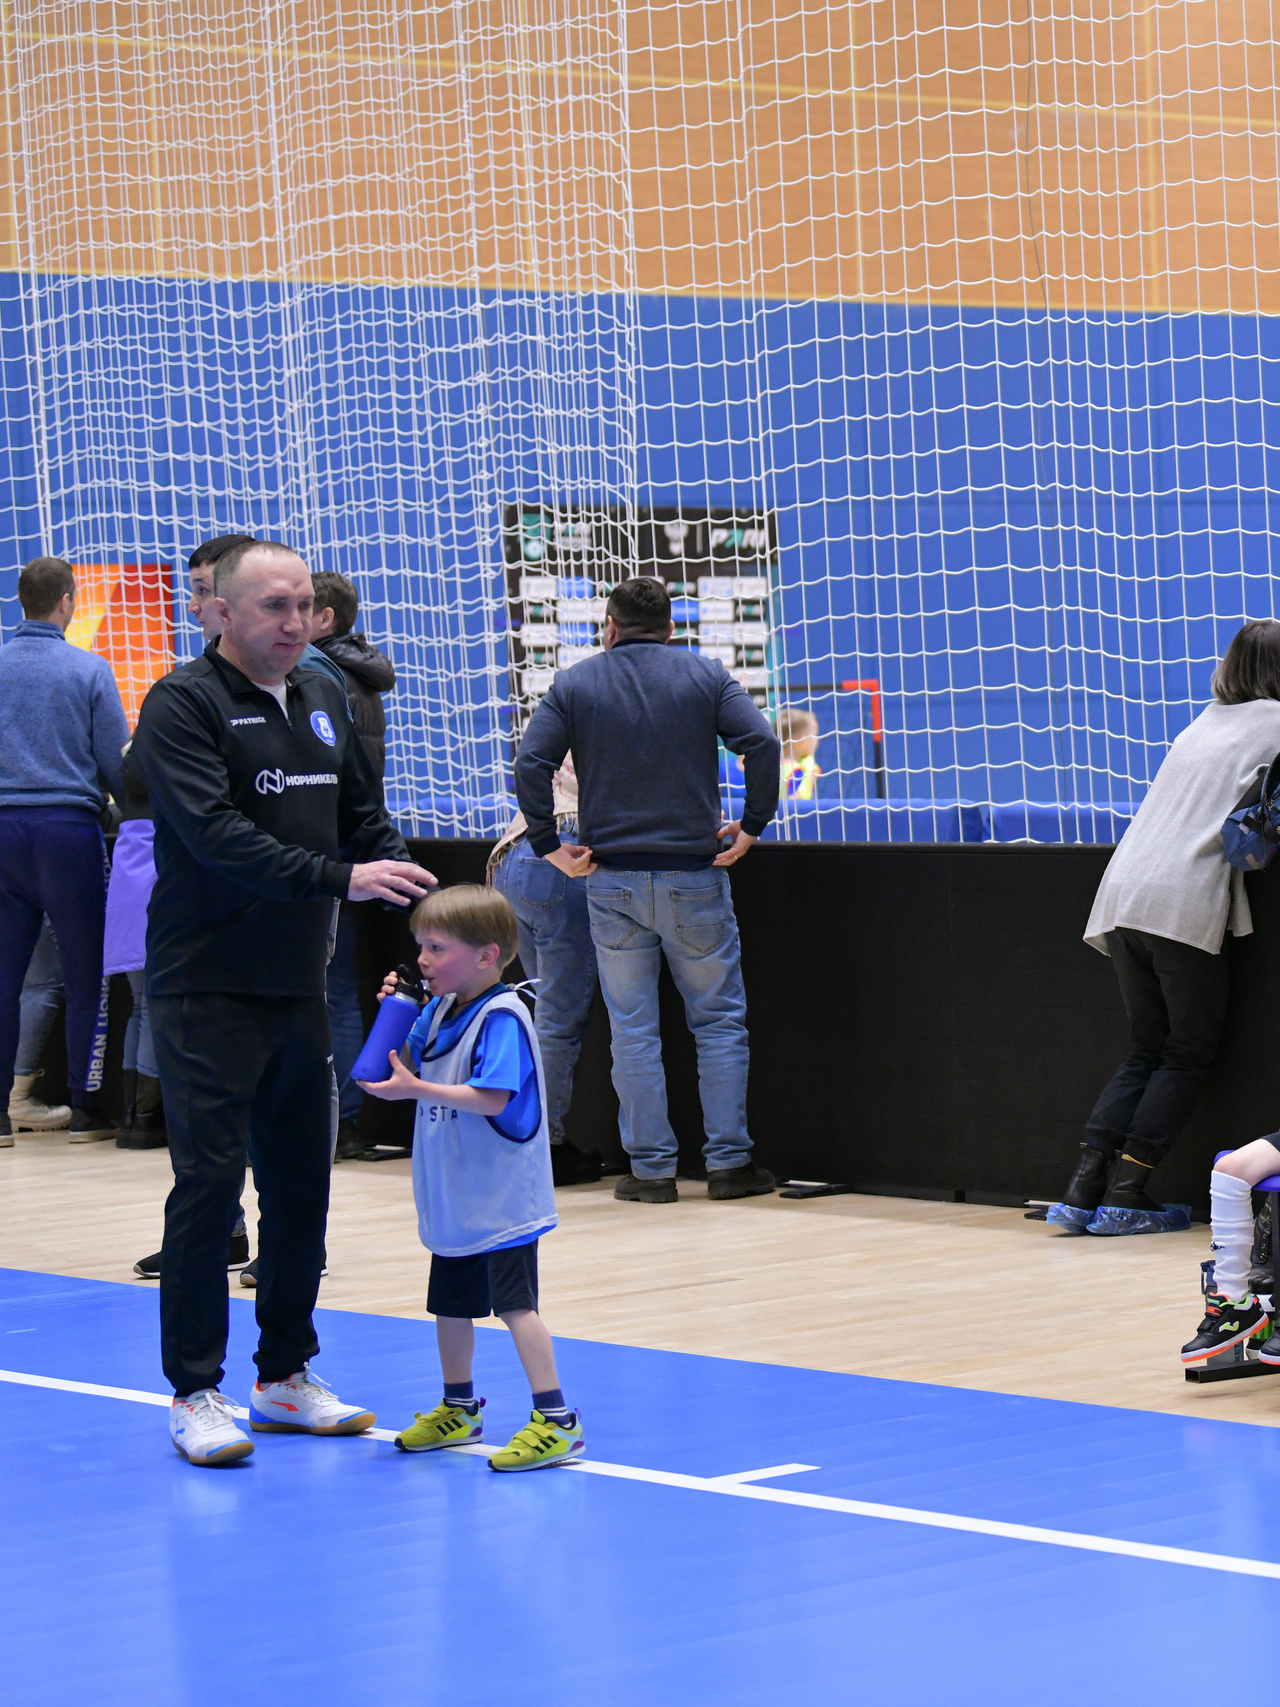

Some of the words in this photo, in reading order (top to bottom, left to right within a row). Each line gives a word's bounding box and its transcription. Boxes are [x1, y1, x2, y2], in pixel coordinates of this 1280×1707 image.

[711, 528, 766, 549] PARI
[239, 717, 267, 726] PATRICK
[285, 774, 338, 786] НОРНИКЕЛЬ
[86, 1034, 108, 1092] URBAN
